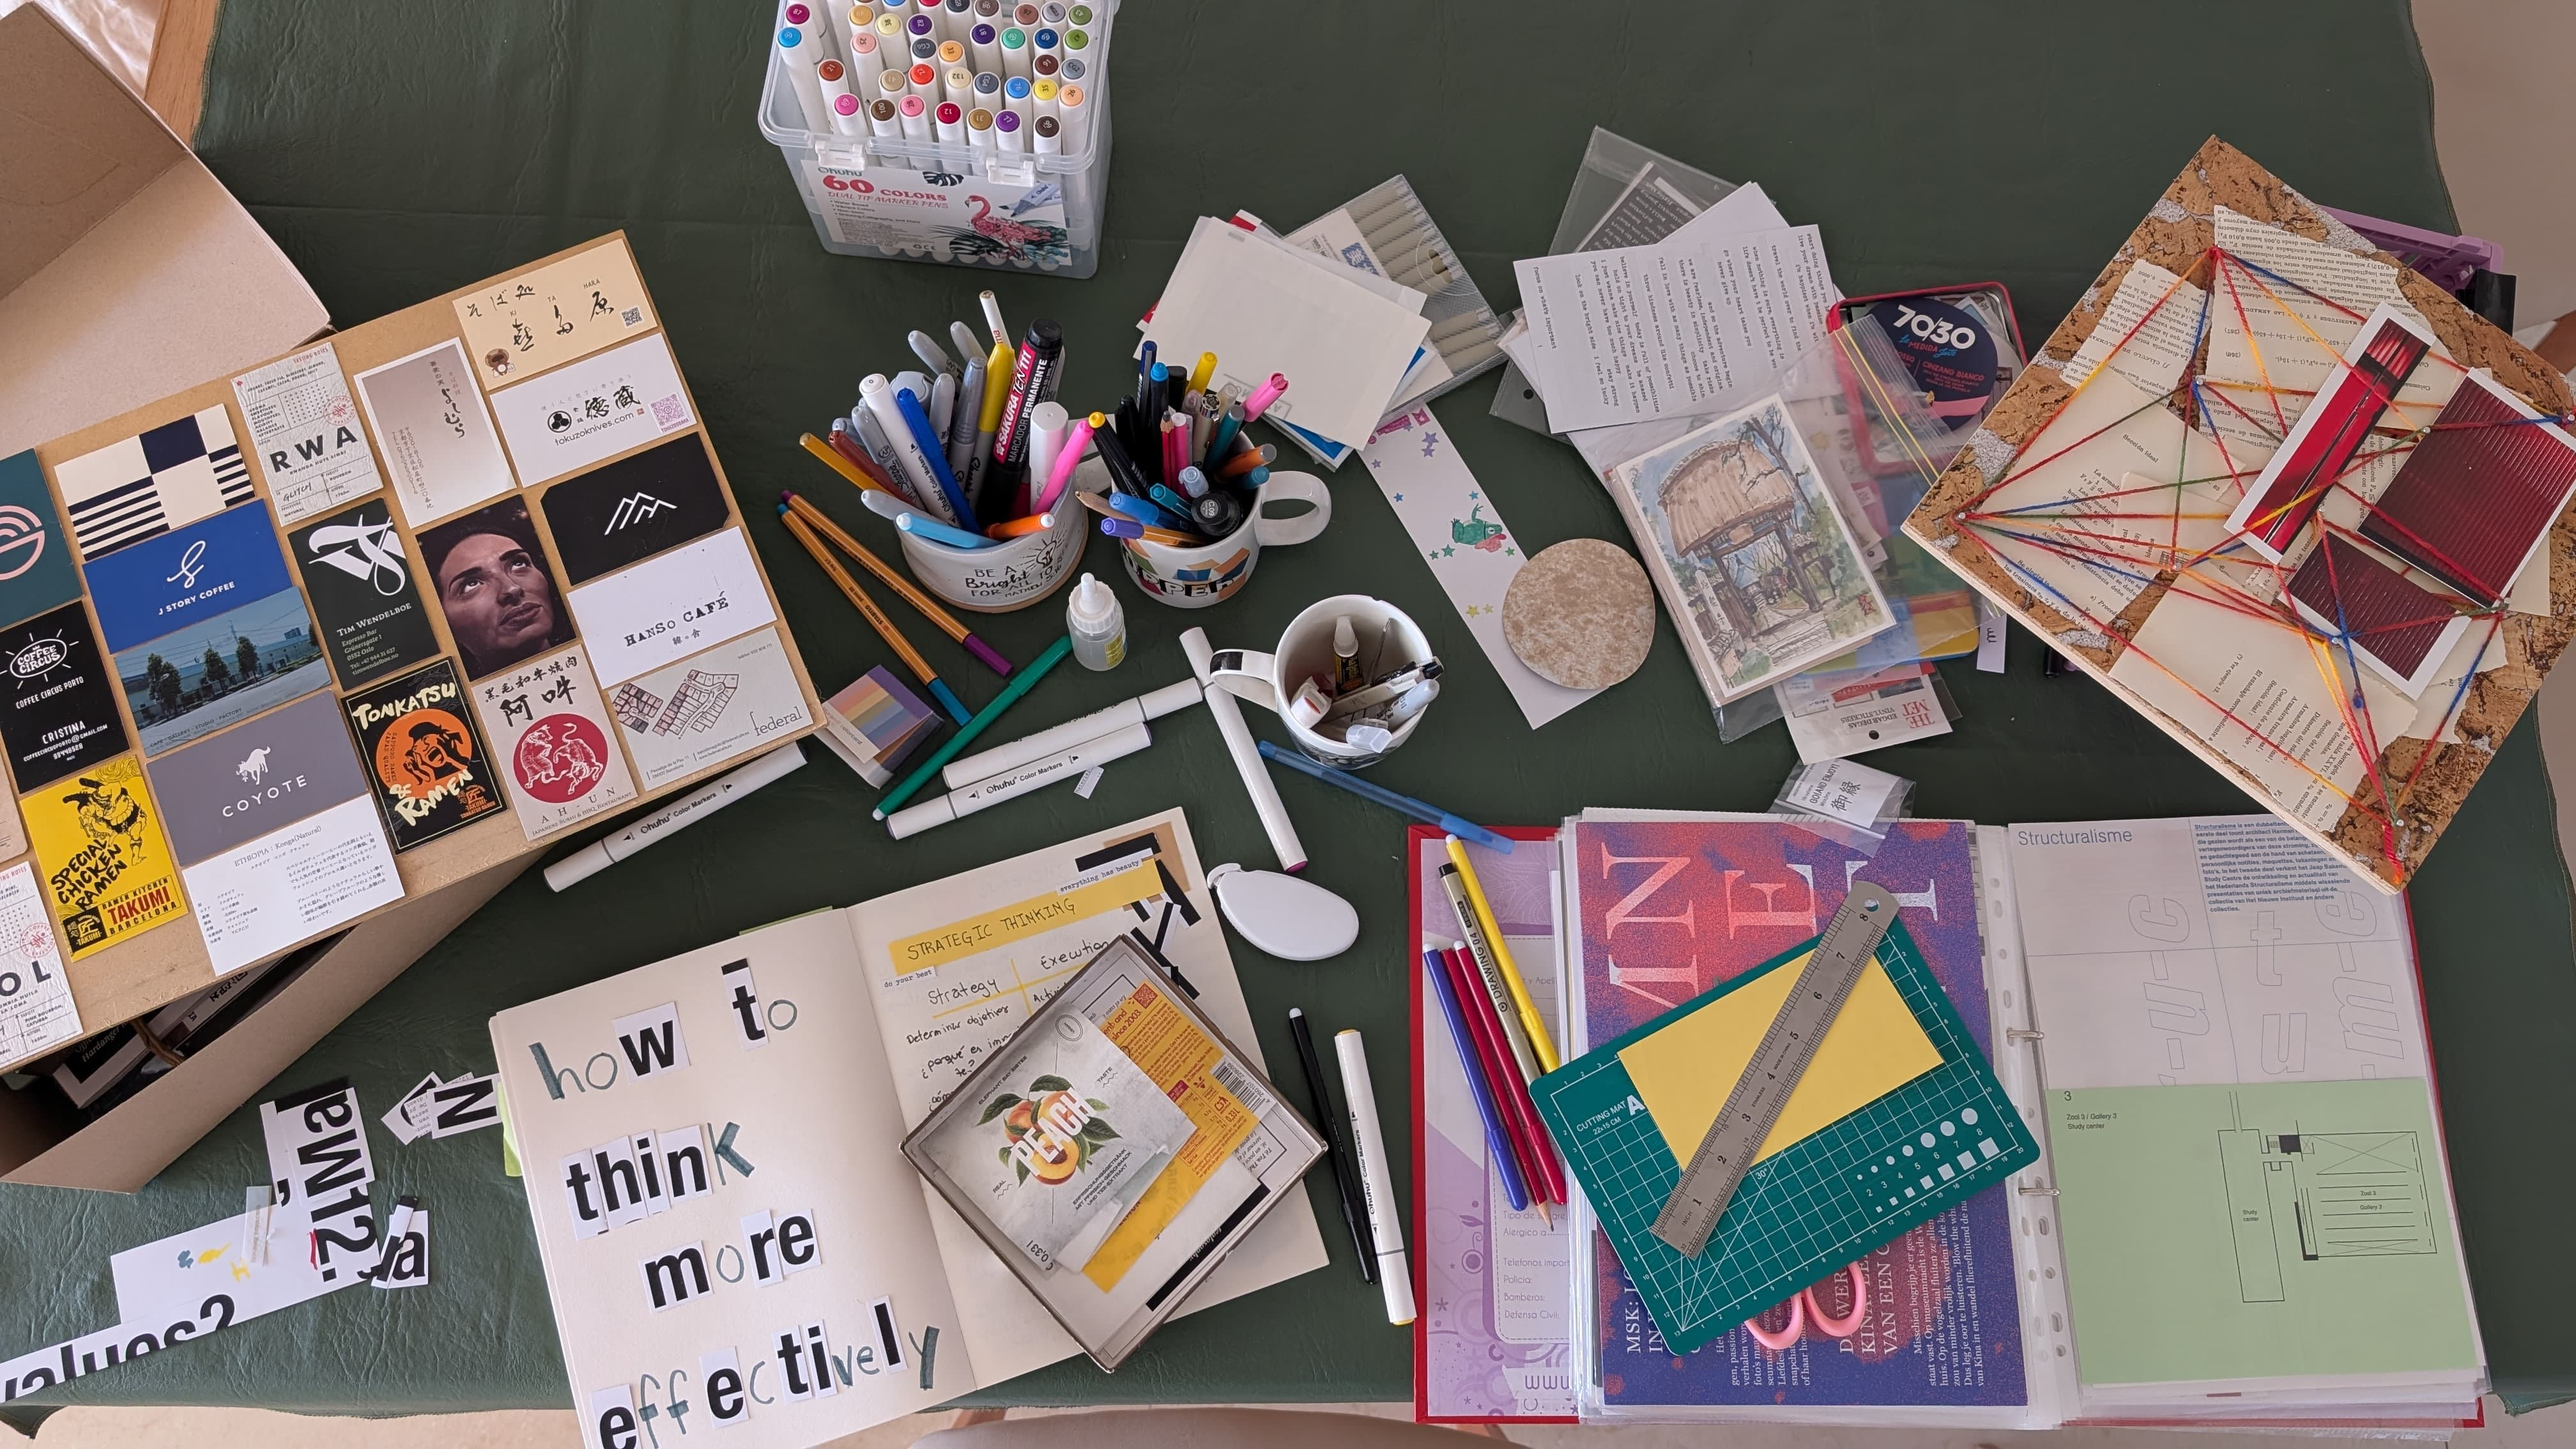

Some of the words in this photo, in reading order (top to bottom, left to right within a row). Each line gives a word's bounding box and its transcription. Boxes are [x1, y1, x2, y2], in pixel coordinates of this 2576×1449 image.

[818, 167, 863, 177] Ohuhu
[823, 175, 875, 193] 60
[880, 189, 947, 201] COLORS
[876, 197, 919, 205] MARKER
[921, 199, 949, 209] PENS
[583, 279, 601, 289] HARA
[1533, 266, 1542, 284] focus
[1538, 285, 1543, 293] on
[1541, 296, 1549, 315] what's
[1545, 314, 1556, 349] important
[1579, 289, 1584, 298] on
[1584, 312, 1593, 334] bright
[1649, 295, 1657, 322] kindness
[1893, 304, 1975, 349] 70/30
[1908, 342, 1938, 352] MEDIDA
[1922, 361, 1954, 376] CINZANO
[1956, 371, 1984, 381] BIANCO
[1000, 394, 1019, 445] SAKURA
[1014, 369, 1026, 395] TEN
[1008, 419, 1028, 463] MARCADOR
[1022, 358, 1048, 418] PERMANENTE
[555, 411, 634, 446] tokuzoknives.com
[2122, 434, 2144, 452] Sección
[2145, 450, 2159, 463] ideal
[918, 455, 930, 475] Markers
[929, 474, 938, 488] Color
[965, 570, 1031, 588] Bright
[975, 569, 995, 577] BE
[1005, 565, 1016, 575] A
[1009, 581, 1032, 590] ALL
[1039, 565, 1052, 579] TO
[166, 596, 196, 613] STORY
[199, 581, 235, 600] COFFEE
[684, 590, 728, 622] CAFÉ
[865, 605, 883, 625] STABILO
[341, 634, 365, 647] Espresso
[362, 647, 374, 655] Oslo
[17, 645, 56, 666] COFFEE
[352, 653, 399, 675] timwendelboe.no
[15, 694, 40, 709] COFFEE
[41, 685, 63, 699] CIRCUS
[64, 676, 84, 690] PORTO
[352, 682, 456, 730] TONKATSU
[1841, 710, 1874, 723] STICKERS
[1873, 714, 1897, 724] EDGAR
[1874, 707, 1895, 717] VINYL
[1901, 700, 1930, 716] MET
[42, 721, 86, 744] CRISTINA
[750, 706, 802, 736] federal
[1848, 718, 1872, 728] DEGAS
[1906, 713, 1935, 729] THE
[1020, 772, 1037, 781] Color
[1038, 762, 1062, 774] Markers
[222, 775, 307, 817] COYOTE
[395, 769, 473, 827] RAMEN
[673, 806, 691, 817] Color
[691, 792, 717, 808] Markers
[1830, 781, 1860, 812] 御縁
[2018, 829, 2132, 845] Structuralisme
[51, 839, 107, 891] SPECIAL
[234, 848, 270, 867] ETHIOPIA
[58, 844, 121, 904] CHICKEN
[75, 860, 128, 910] RAMEN
[1060, 875, 1100, 893] everything
[1101, 869, 1114, 878] has
[1116, 859, 1140, 875] beauty
[102, 895, 130, 910] RAMEN
[133, 878, 168, 896] KITCHEN
[107, 886, 171, 925] TAKUMI
[109, 901, 176, 935] BARCELONA
[907, 924, 992, 960] STRATEGIC
[1000, 898, 1075, 931] THINKING
[1470, 932, 1480, 945] 04
[895, 975, 914, 986] your
[915, 969, 932, 979] best
[1475, 949, 1503, 999] DRAWING
[928, 978, 1000, 1005] Strategy
[528, 1020, 676, 1100] how
[732, 986, 797, 1041] to
[1112, 1027, 1126, 1041] since
[978, 1082, 1002, 1105] ELEPHANT
[1001, 1070, 1014, 1084] BAY
[1096, 1066, 1113, 1084] TASTE
[2064, 1091, 2071, 1101] 3
[1225, 1108, 1240, 1123] 0,33L
[1576, 1110, 1611, 1131] CUTTING
[1610, 1100, 1626, 1114] MAT
[1593, 1122, 1611, 1135] 22x15
[1610, 1117, 1621, 1126] CM
[1009, 1087, 1098, 1177] PEACH
[566, 1123, 755, 1221] think
[1087, 1196, 1097, 1206] UND
[1096, 1163, 1128, 1198] TEE-EXTRAKT
[992, 1179, 1007, 1194] REAL
[1075, 1199, 1085, 1211] MIT
[1682, 1210, 1693, 1227] INCH
[1503, 1228, 1537, 1237] Alergico
[645, 1213, 814, 1309] more
[1504, 1292, 1545, 1301] Bomberos:
[1878, 1263, 1895, 1308] EEN
[1505, 1310, 1537, 1319] Defensa
[1540, 1310, 1559, 1319] Civil:
[1969, 1291, 1978, 1320] wandel
[1625, 1299, 1641, 1353] MSK:
[1879, 1311, 1897, 1354] VAN
[1911, 1308, 1922, 1354] Misschien
[599, 1326, 940, 1449] effectively
